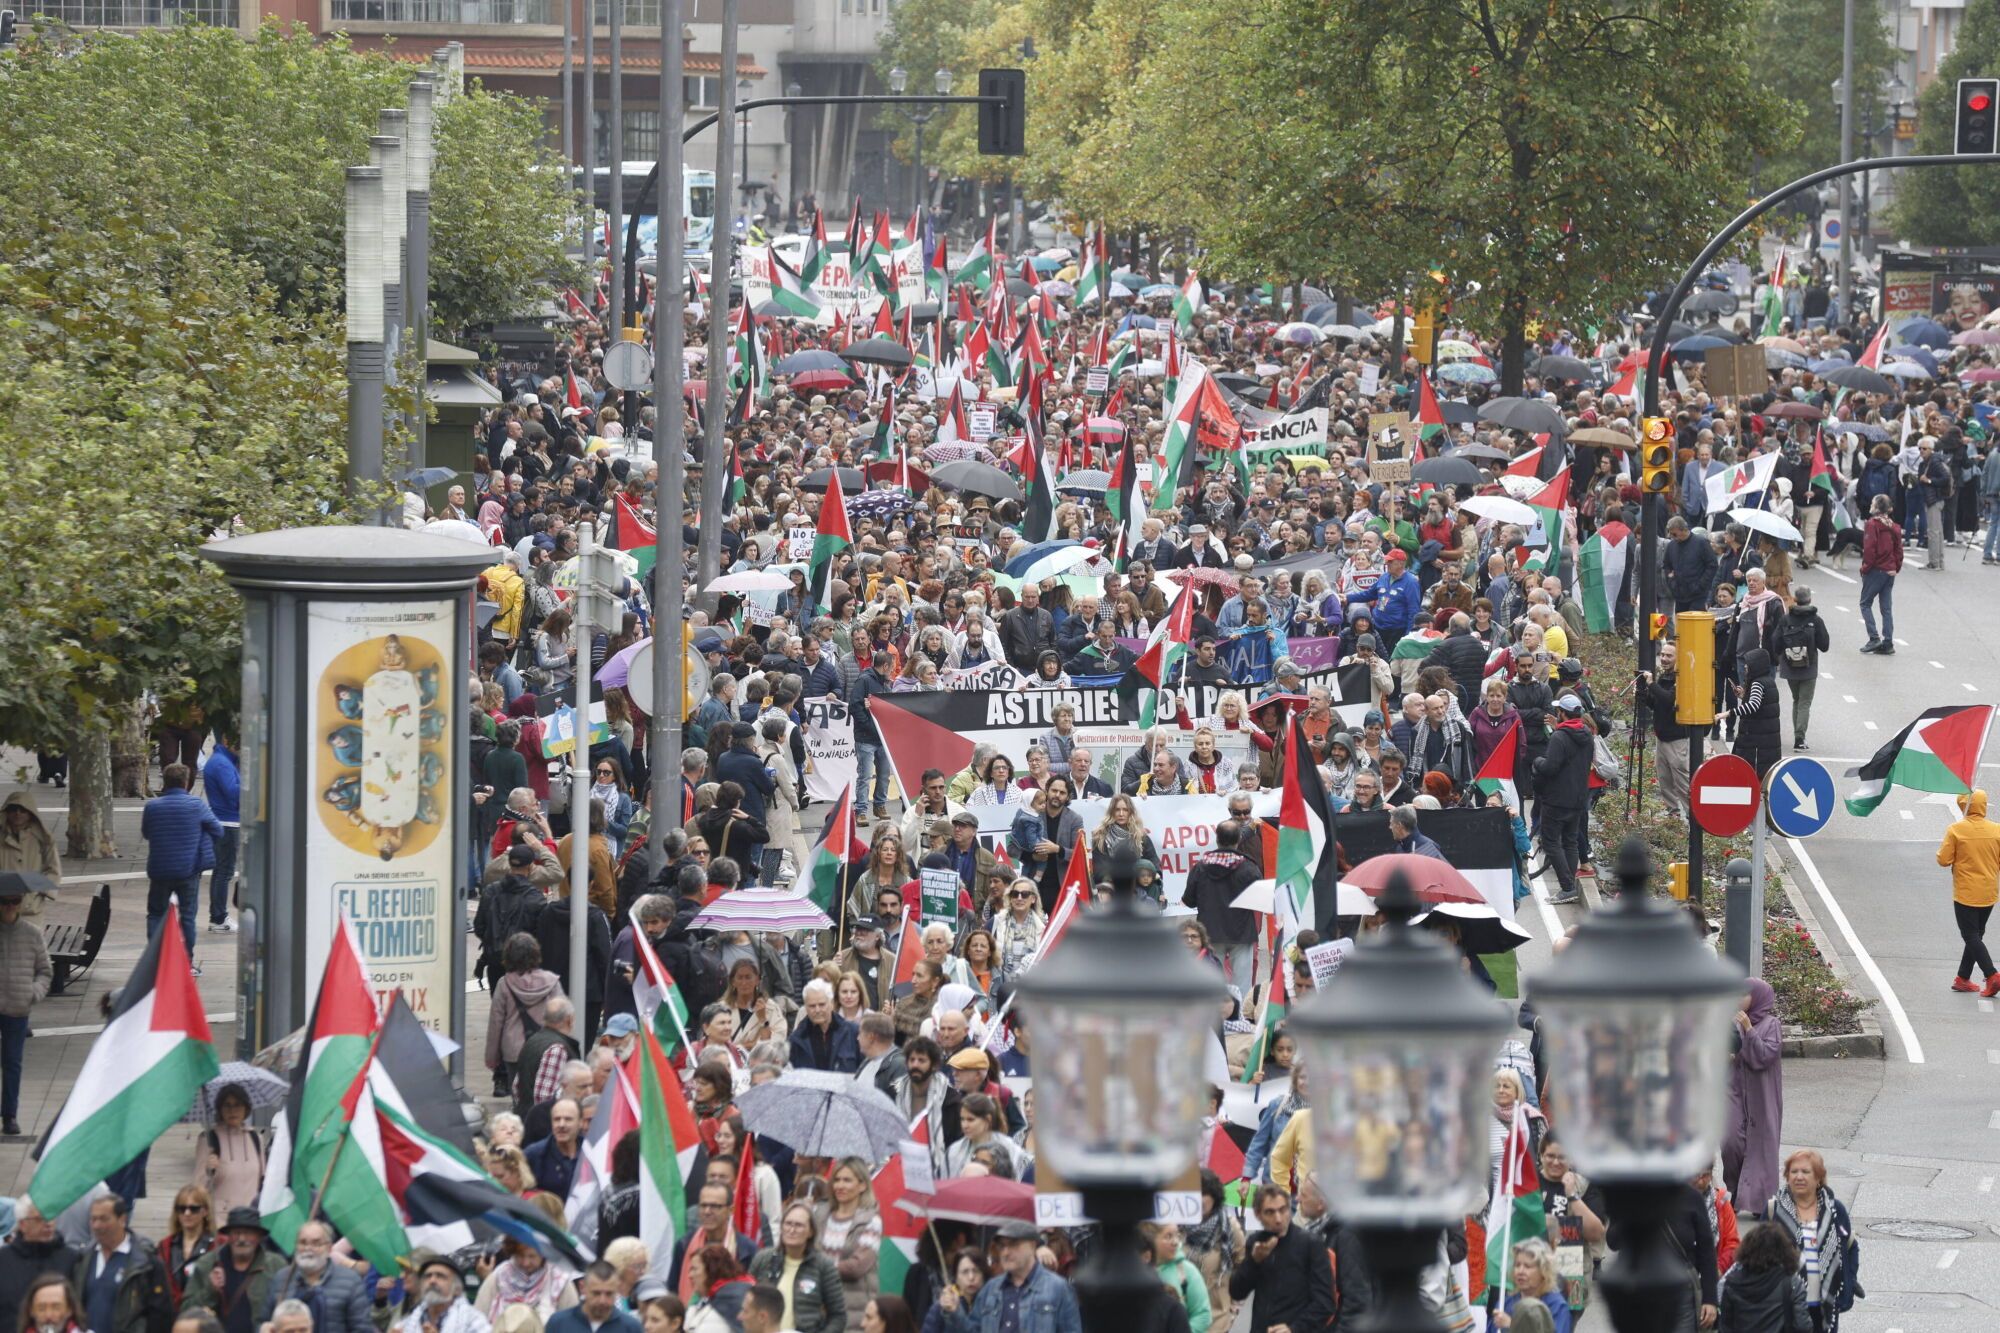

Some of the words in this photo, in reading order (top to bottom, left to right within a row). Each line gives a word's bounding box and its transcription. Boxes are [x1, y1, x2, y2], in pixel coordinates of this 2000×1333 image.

[793, 530, 806, 538] NO
[1293, 645, 1322, 658] LAS
[986, 690, 1119, 725] ASTURIES
[1117, 734, 1142, 743] Palestina
[948, 874, 957, 883] DE
[368, 887, 435, 918] REFUGIO
[354, 918, 435, 957] TÓMICO
[1311, 948, 1342, 961] HUELGA
[400, 973, 413, 982] EN
[1039, 1199, 1062, 1218] DE
